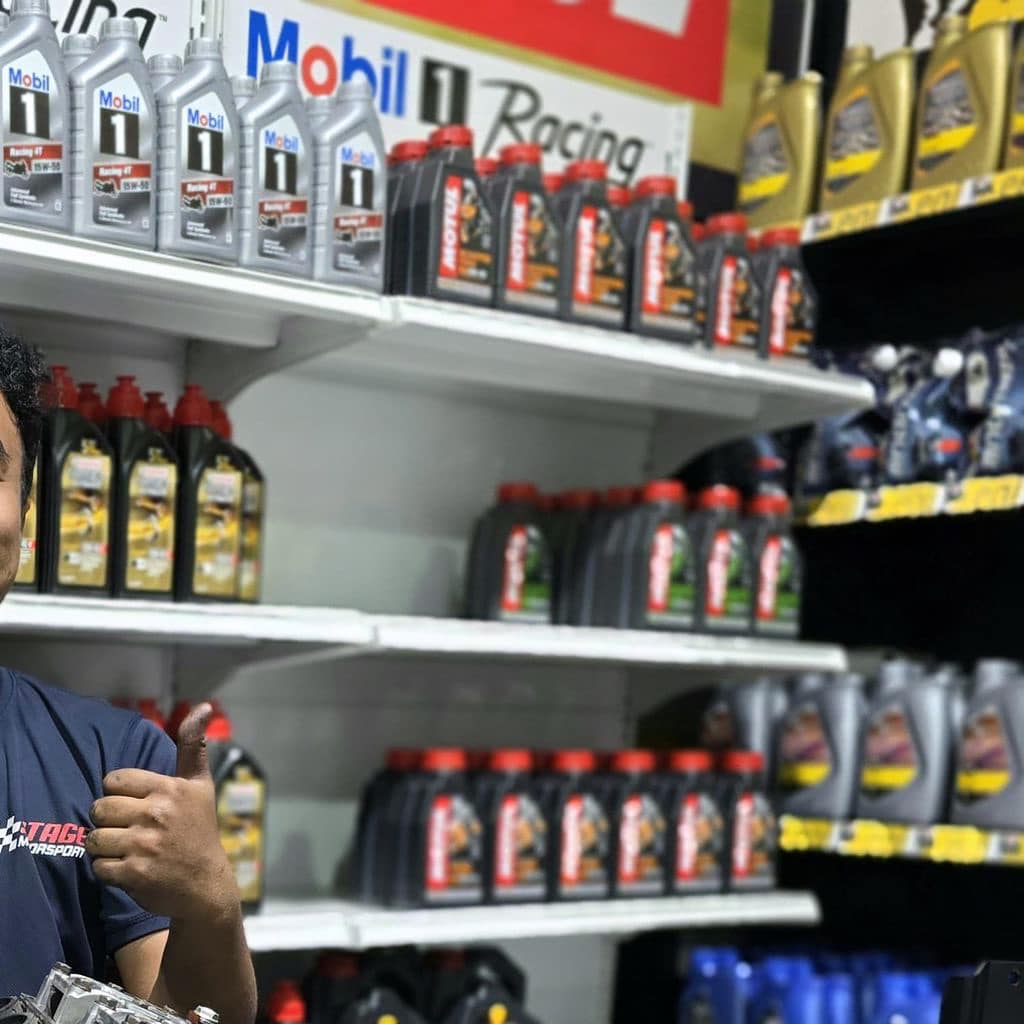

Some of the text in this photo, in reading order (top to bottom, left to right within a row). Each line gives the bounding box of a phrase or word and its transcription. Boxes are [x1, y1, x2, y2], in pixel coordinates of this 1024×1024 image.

[9, 67, 49, 91] Mobil
[100, 90, 139, 112] Mobil
[247, 9, 407, 117] Mobil
[480, 79, 644, 185] Racing
[188, 108, 224, 130] Mobil
[265, 130, 298, 152] Mobil
